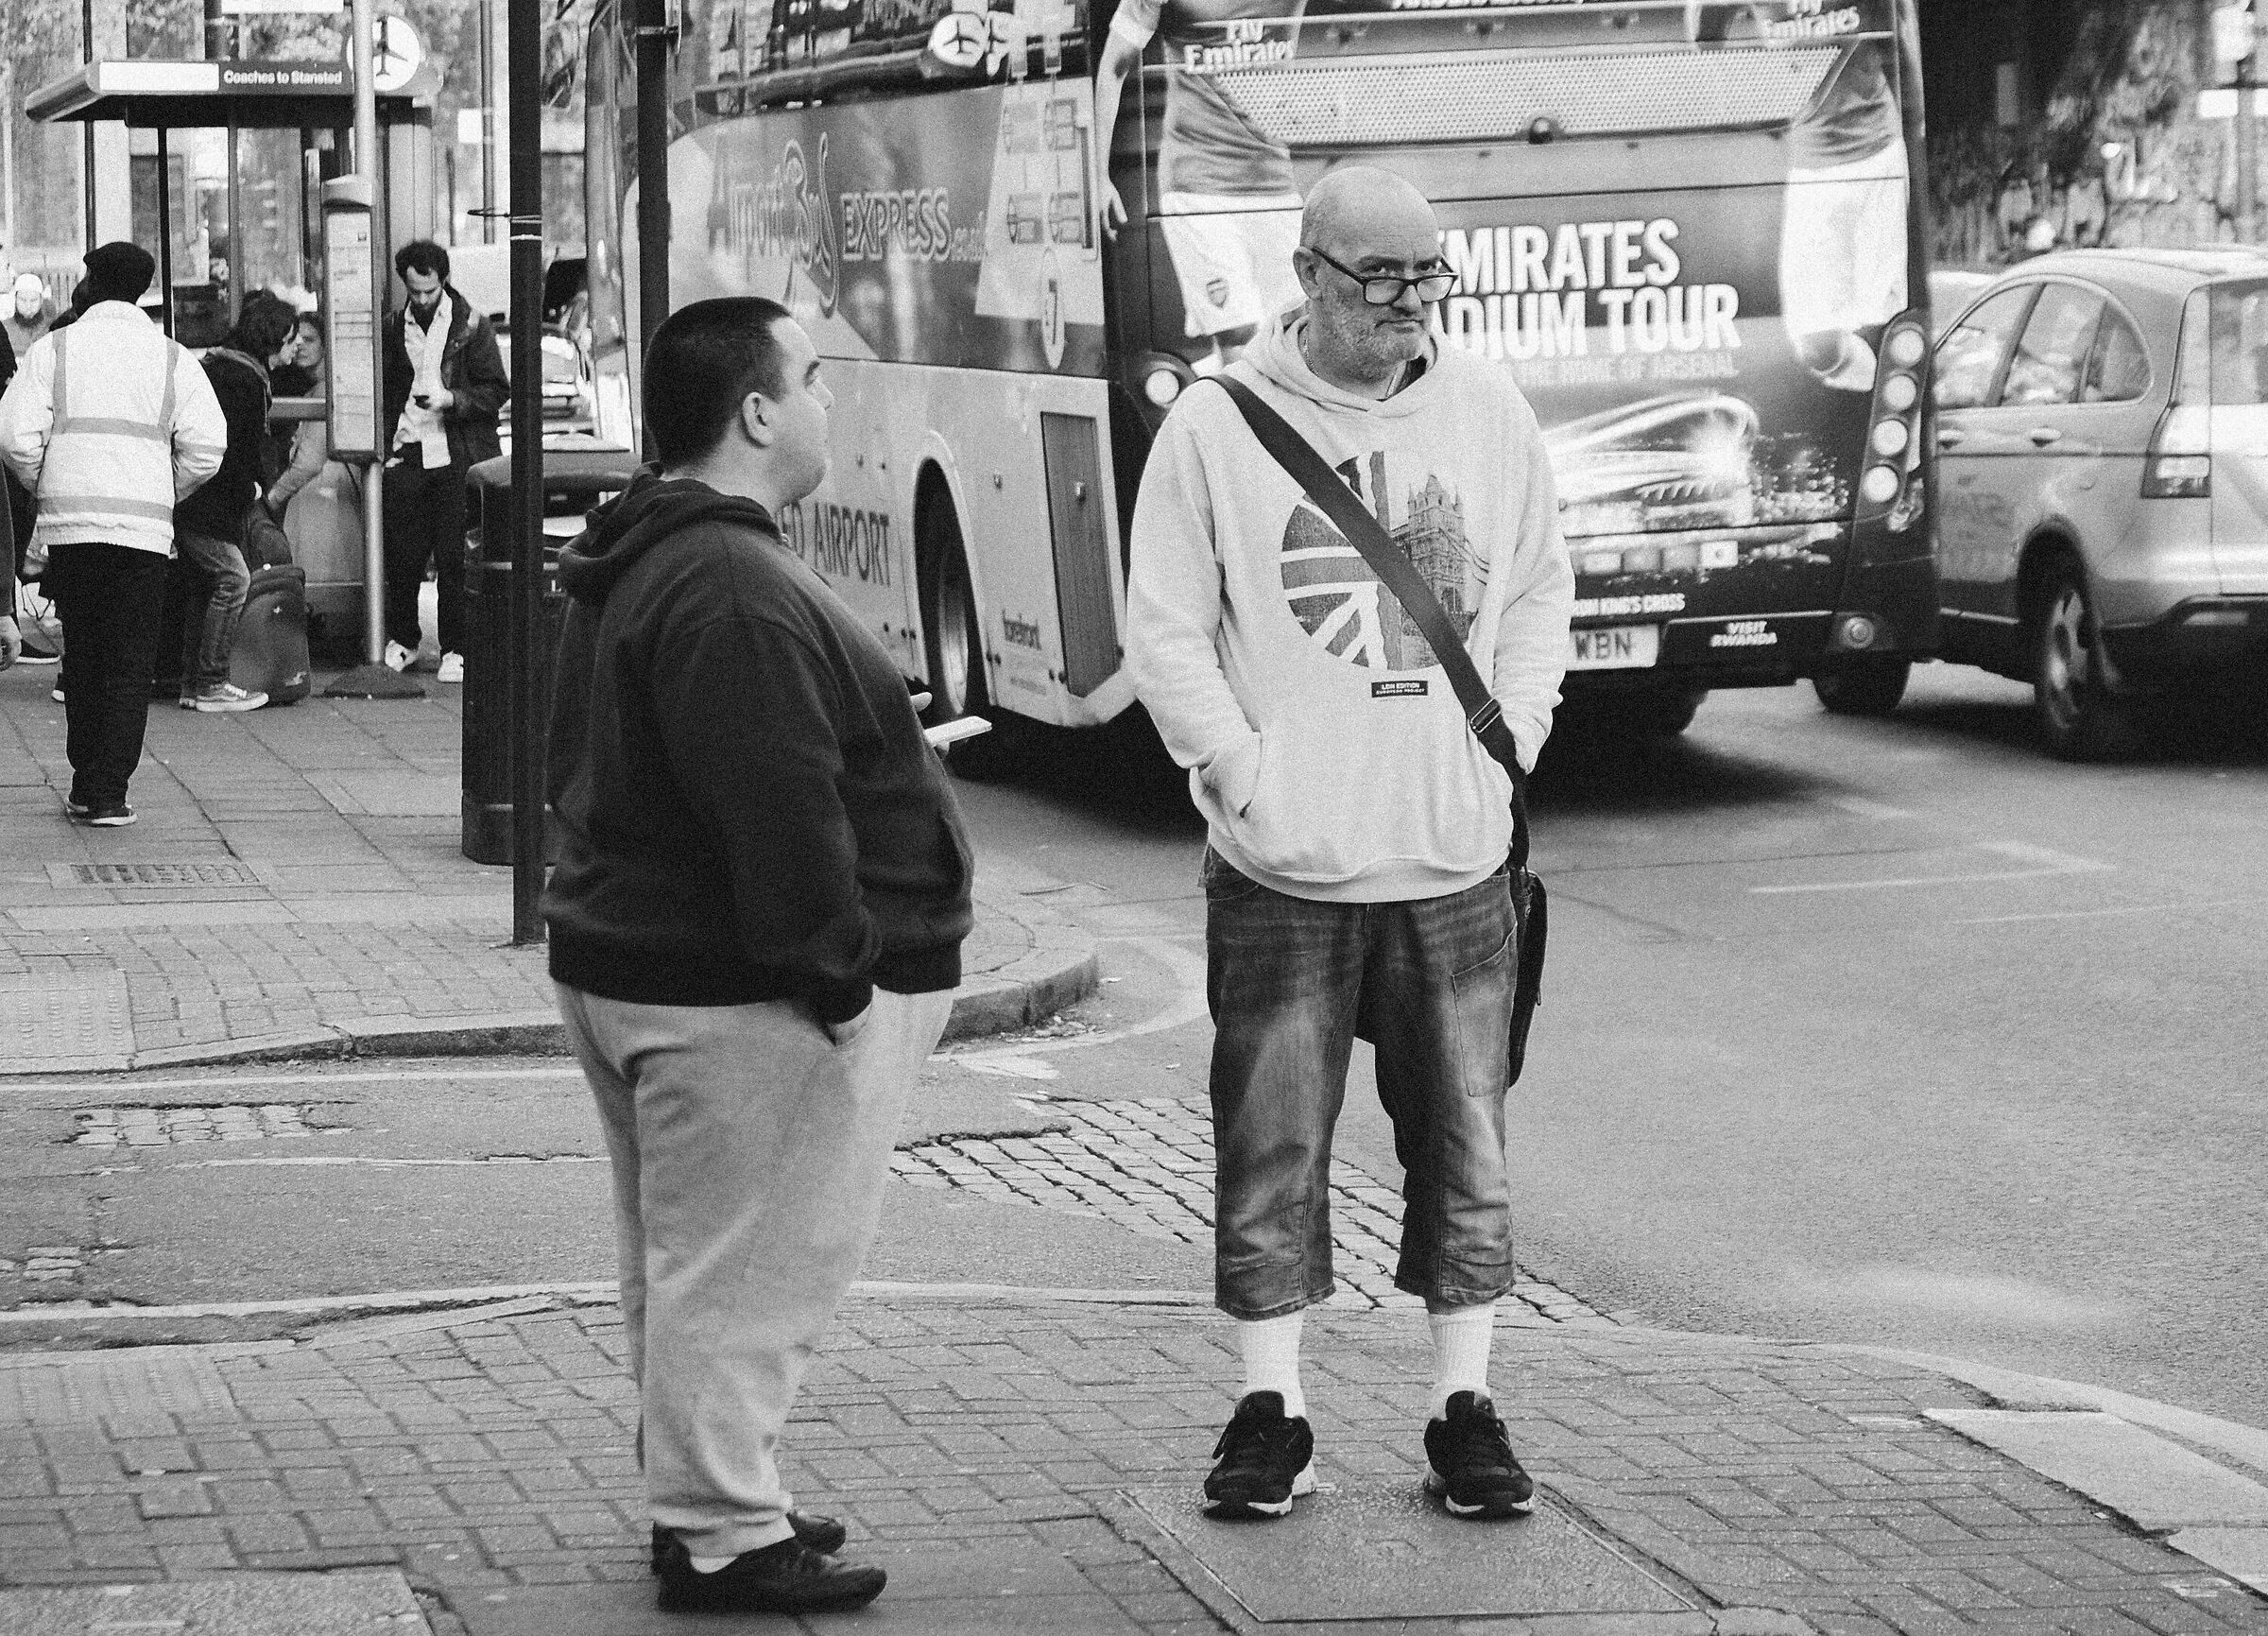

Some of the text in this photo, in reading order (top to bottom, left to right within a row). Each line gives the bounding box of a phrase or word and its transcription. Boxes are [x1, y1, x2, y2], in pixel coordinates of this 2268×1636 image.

[223, 69, 343, 85] Coaches to Stansted
[840, 187, 952, 263] EXPRESS
[1437, 216, 1682, 297] MIRATES
[1430, 284, 1744, 361] DIUM TOUR
[814, 500, 892, 587] AIRPORT
[1600, 595, 1642, 616] KING'S
[1642, 593, 1686, 613] CROSS
[1710, 631, 1778, 647] RWANDA
[1727, 620, 1768, 634] VISIT
[1574, 629, 1633, 660] WBN
